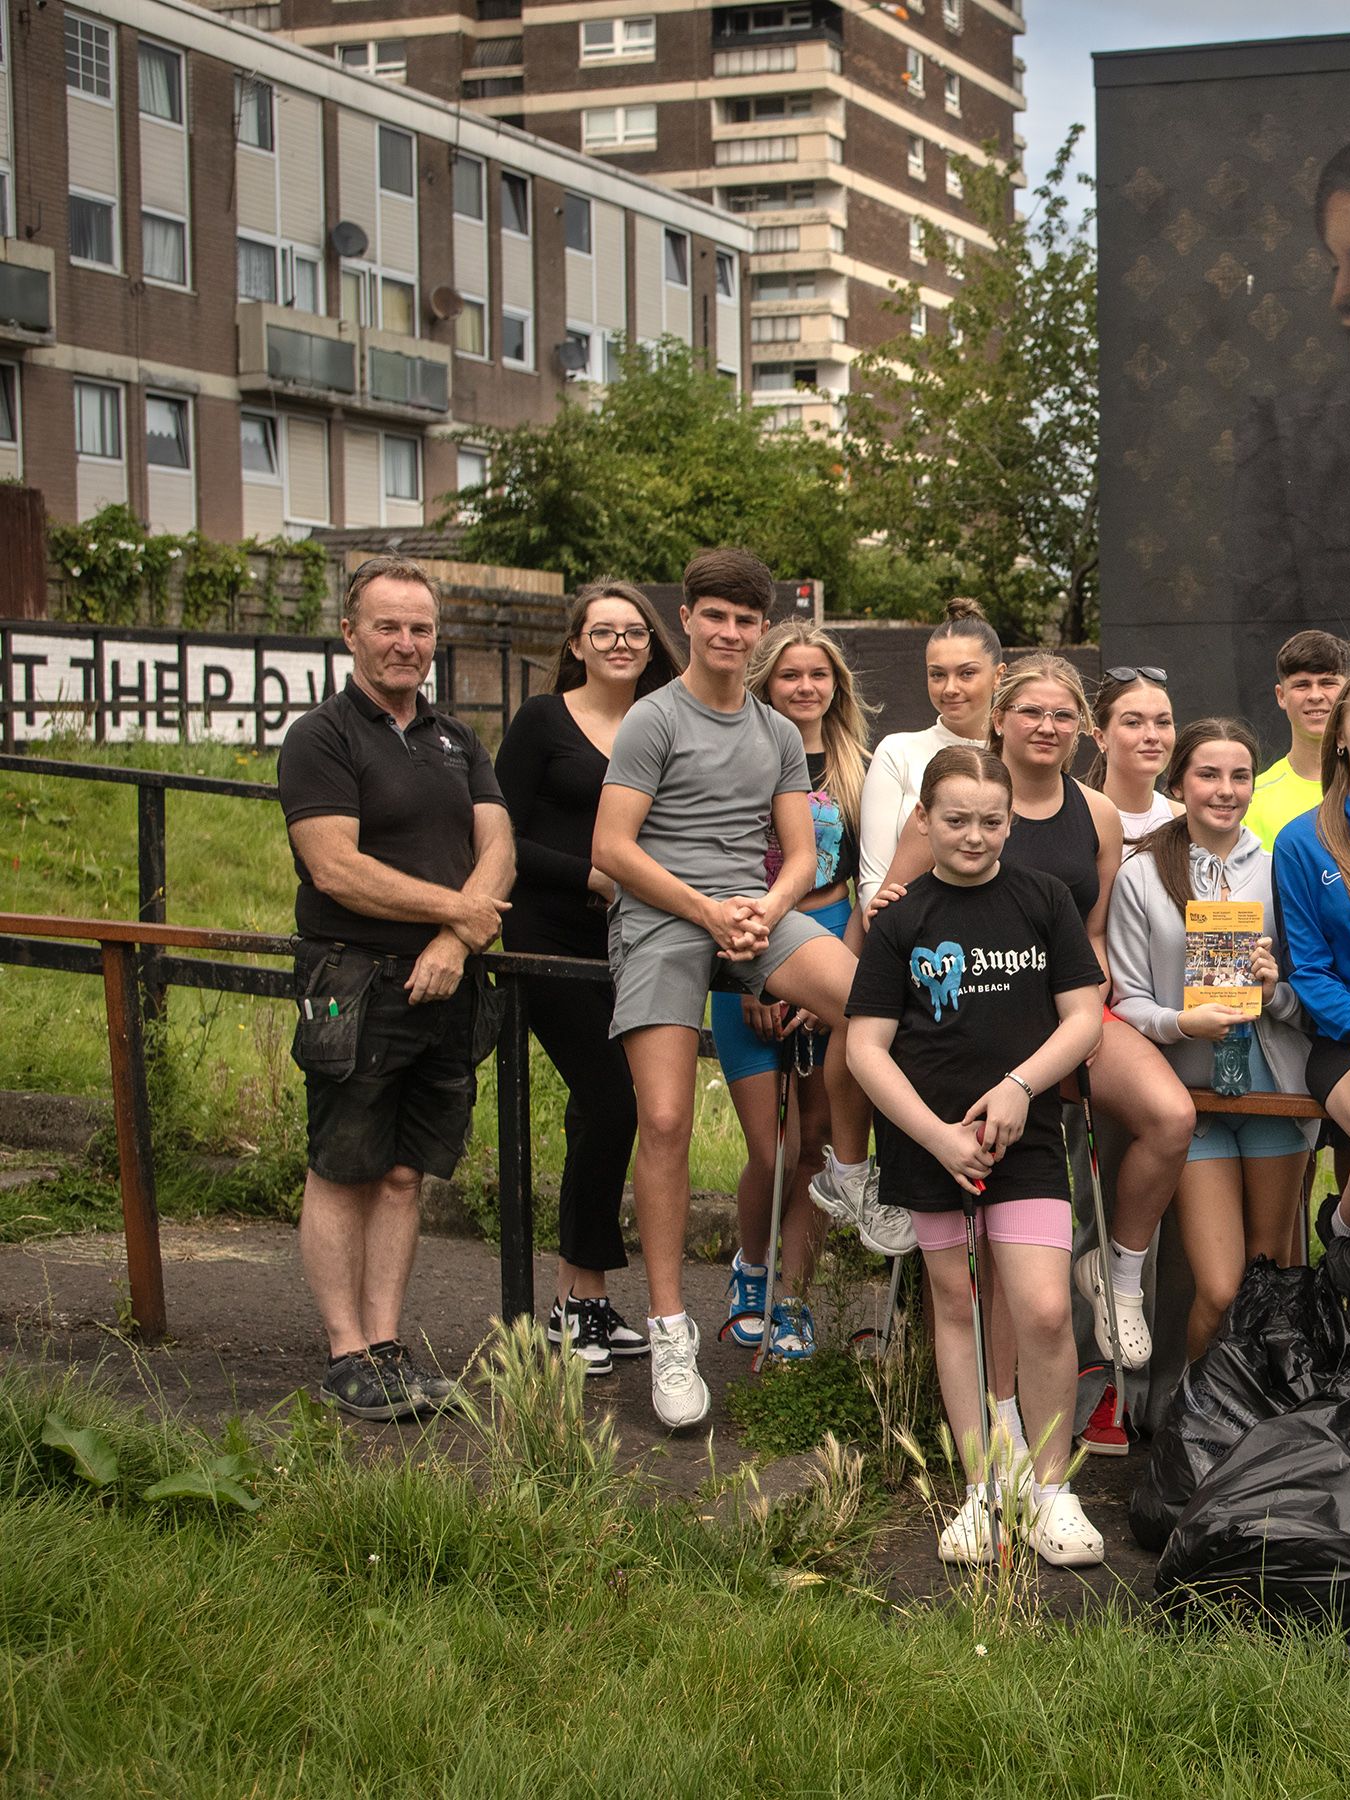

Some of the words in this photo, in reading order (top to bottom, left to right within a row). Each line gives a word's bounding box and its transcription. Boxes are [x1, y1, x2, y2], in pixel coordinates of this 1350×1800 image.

[70, 656, 180, 729] THE
[970, 945, 1047, 977] Angels
[978, 983, 1011, 994] BEACH
[1222, 1415, 1246, 1437] City
